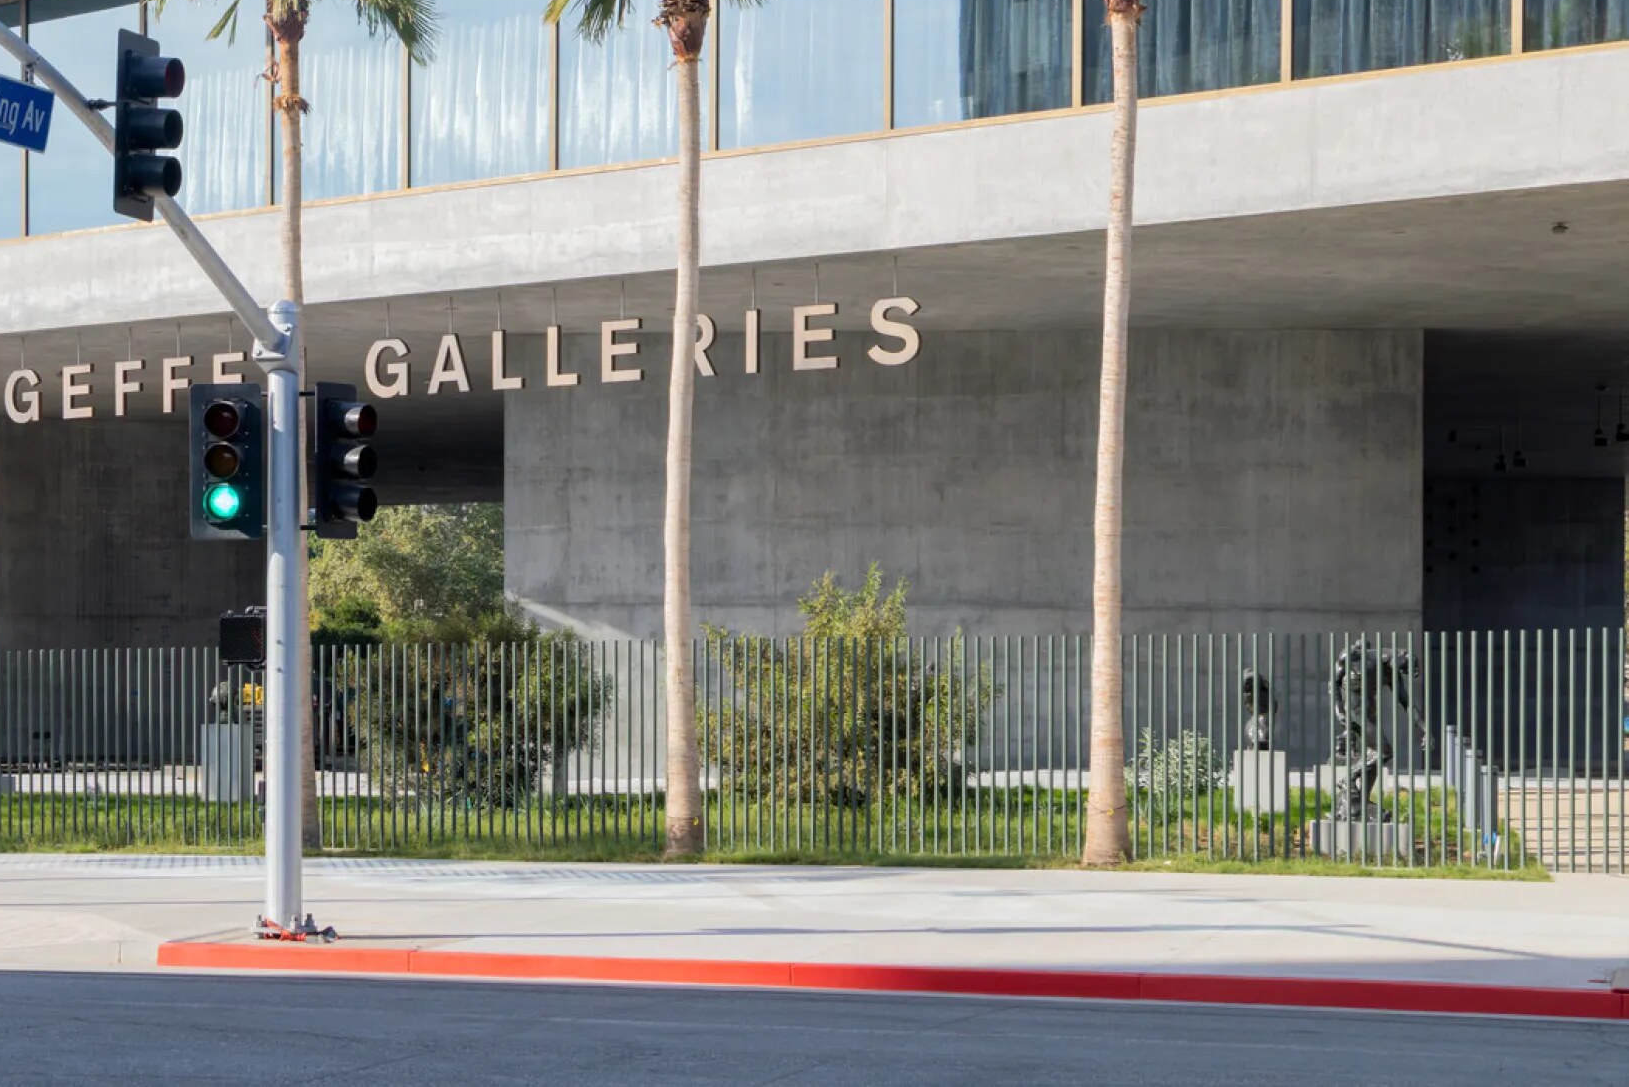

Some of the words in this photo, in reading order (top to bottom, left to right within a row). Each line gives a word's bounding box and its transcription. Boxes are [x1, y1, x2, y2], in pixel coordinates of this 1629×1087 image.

[21, 99, 46, 132] Av
[4, 347, 305, 424] GEFFE
[364, 296, 921, 399] GALLERIES
